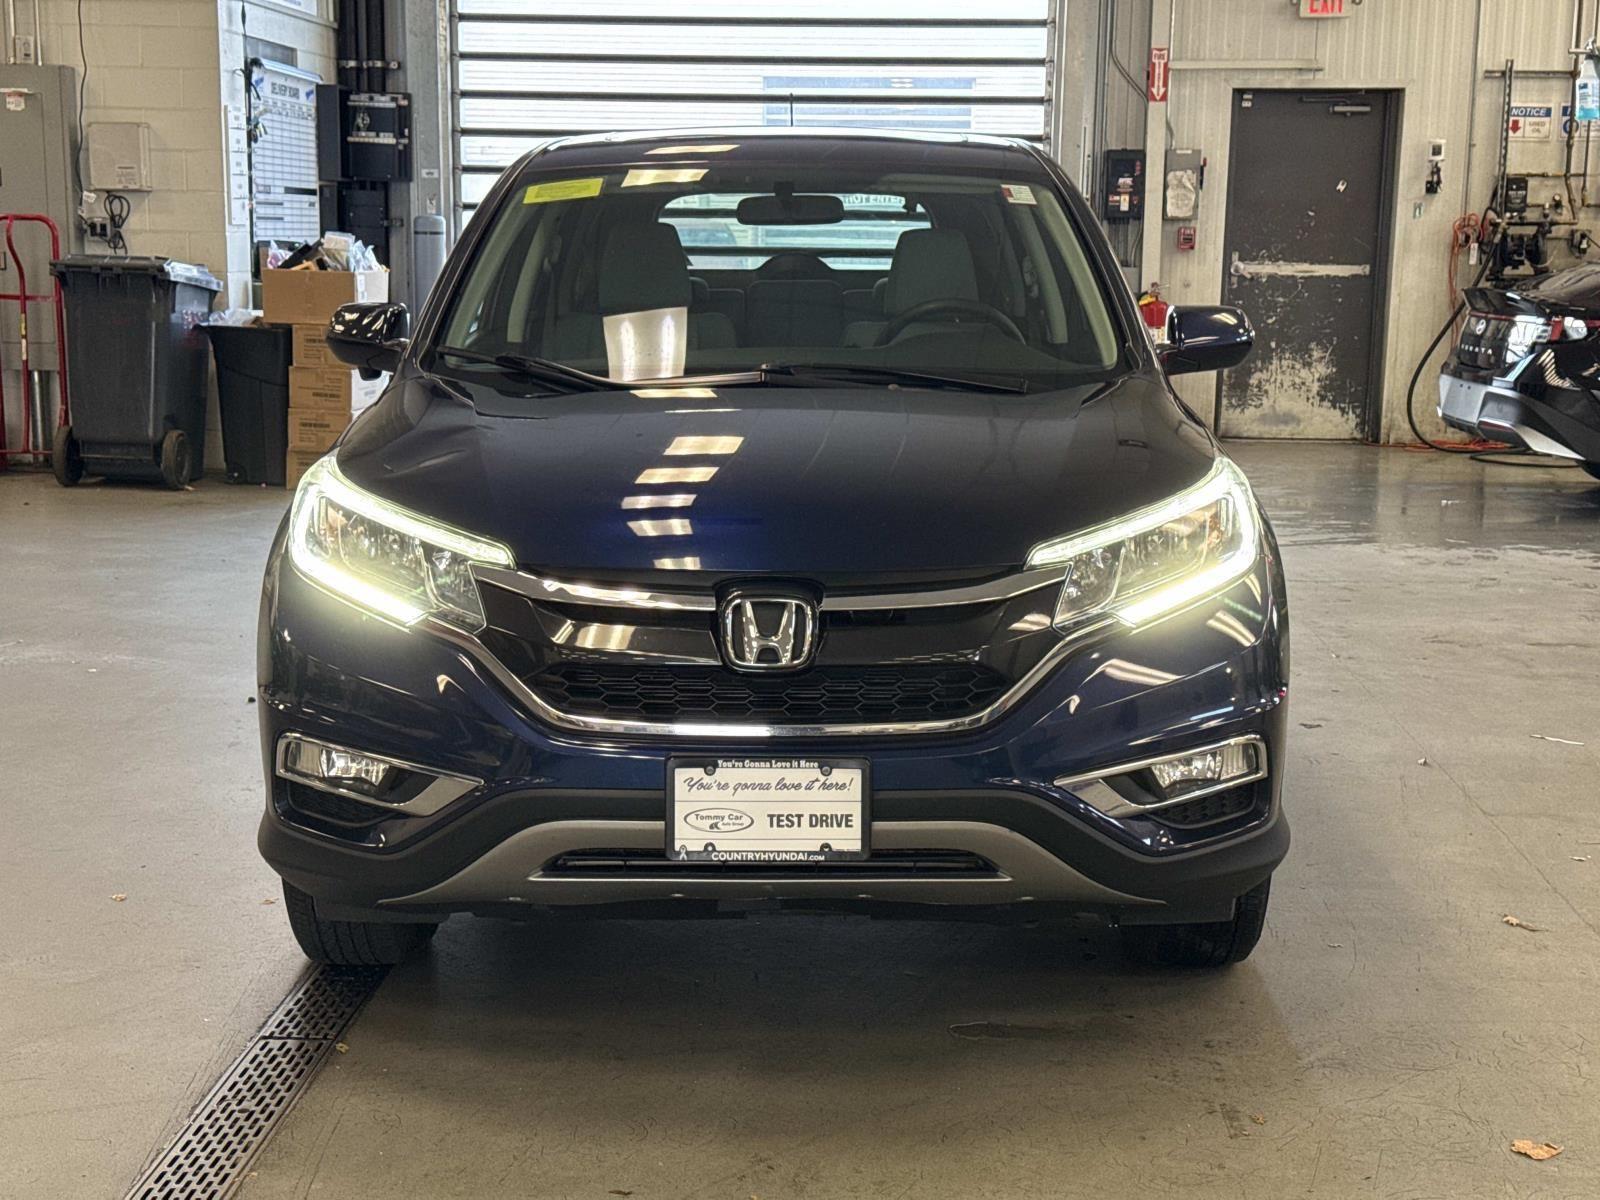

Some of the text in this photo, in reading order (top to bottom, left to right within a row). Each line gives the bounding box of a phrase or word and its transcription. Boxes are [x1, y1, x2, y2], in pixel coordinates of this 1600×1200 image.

[1153, 52, 1165, 60] FIRE
[1511, 108, 1547, 116] NOTICE
[1461, 343, 1493, 355] ATA
[717, 759, 819, 768] You're Gonna Love it Here
[683, 776, 854, 797] You're gonna love it here!
[694, 813, 726, 822] Tommy
[767, 813, 854, 828] TEST DRIVE
